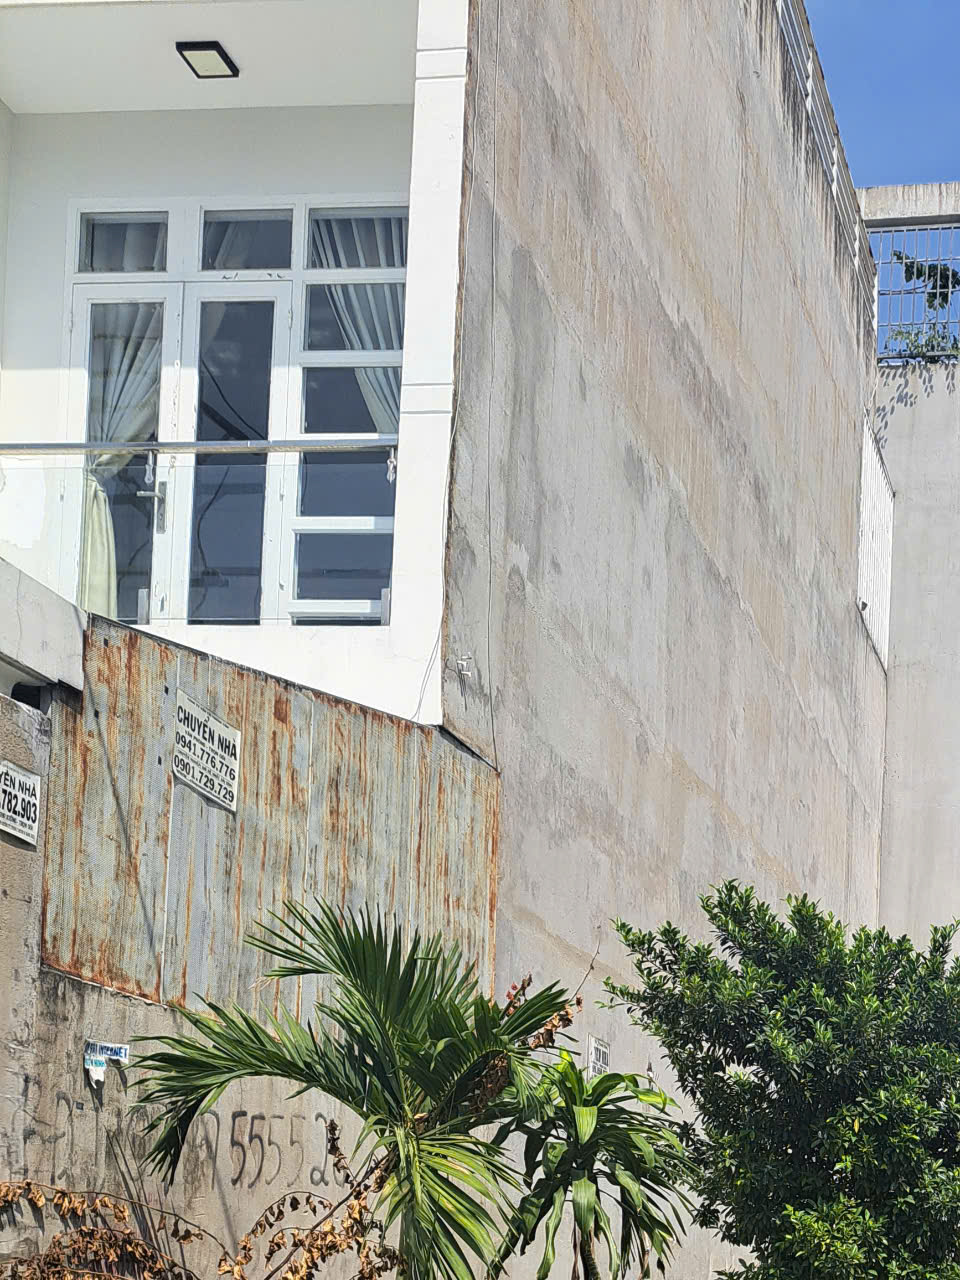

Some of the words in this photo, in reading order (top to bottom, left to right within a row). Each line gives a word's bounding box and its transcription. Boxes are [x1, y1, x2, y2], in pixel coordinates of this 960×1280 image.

[175, 731, 236, 781] 0941.776.776
[177, 705, 215, 746] CHUYỂN
[218, 733, 237, 761] NHÀ
[18, 779, 37, 800] NHÀ
[174, 754, 235, 803] 0901.729.729
